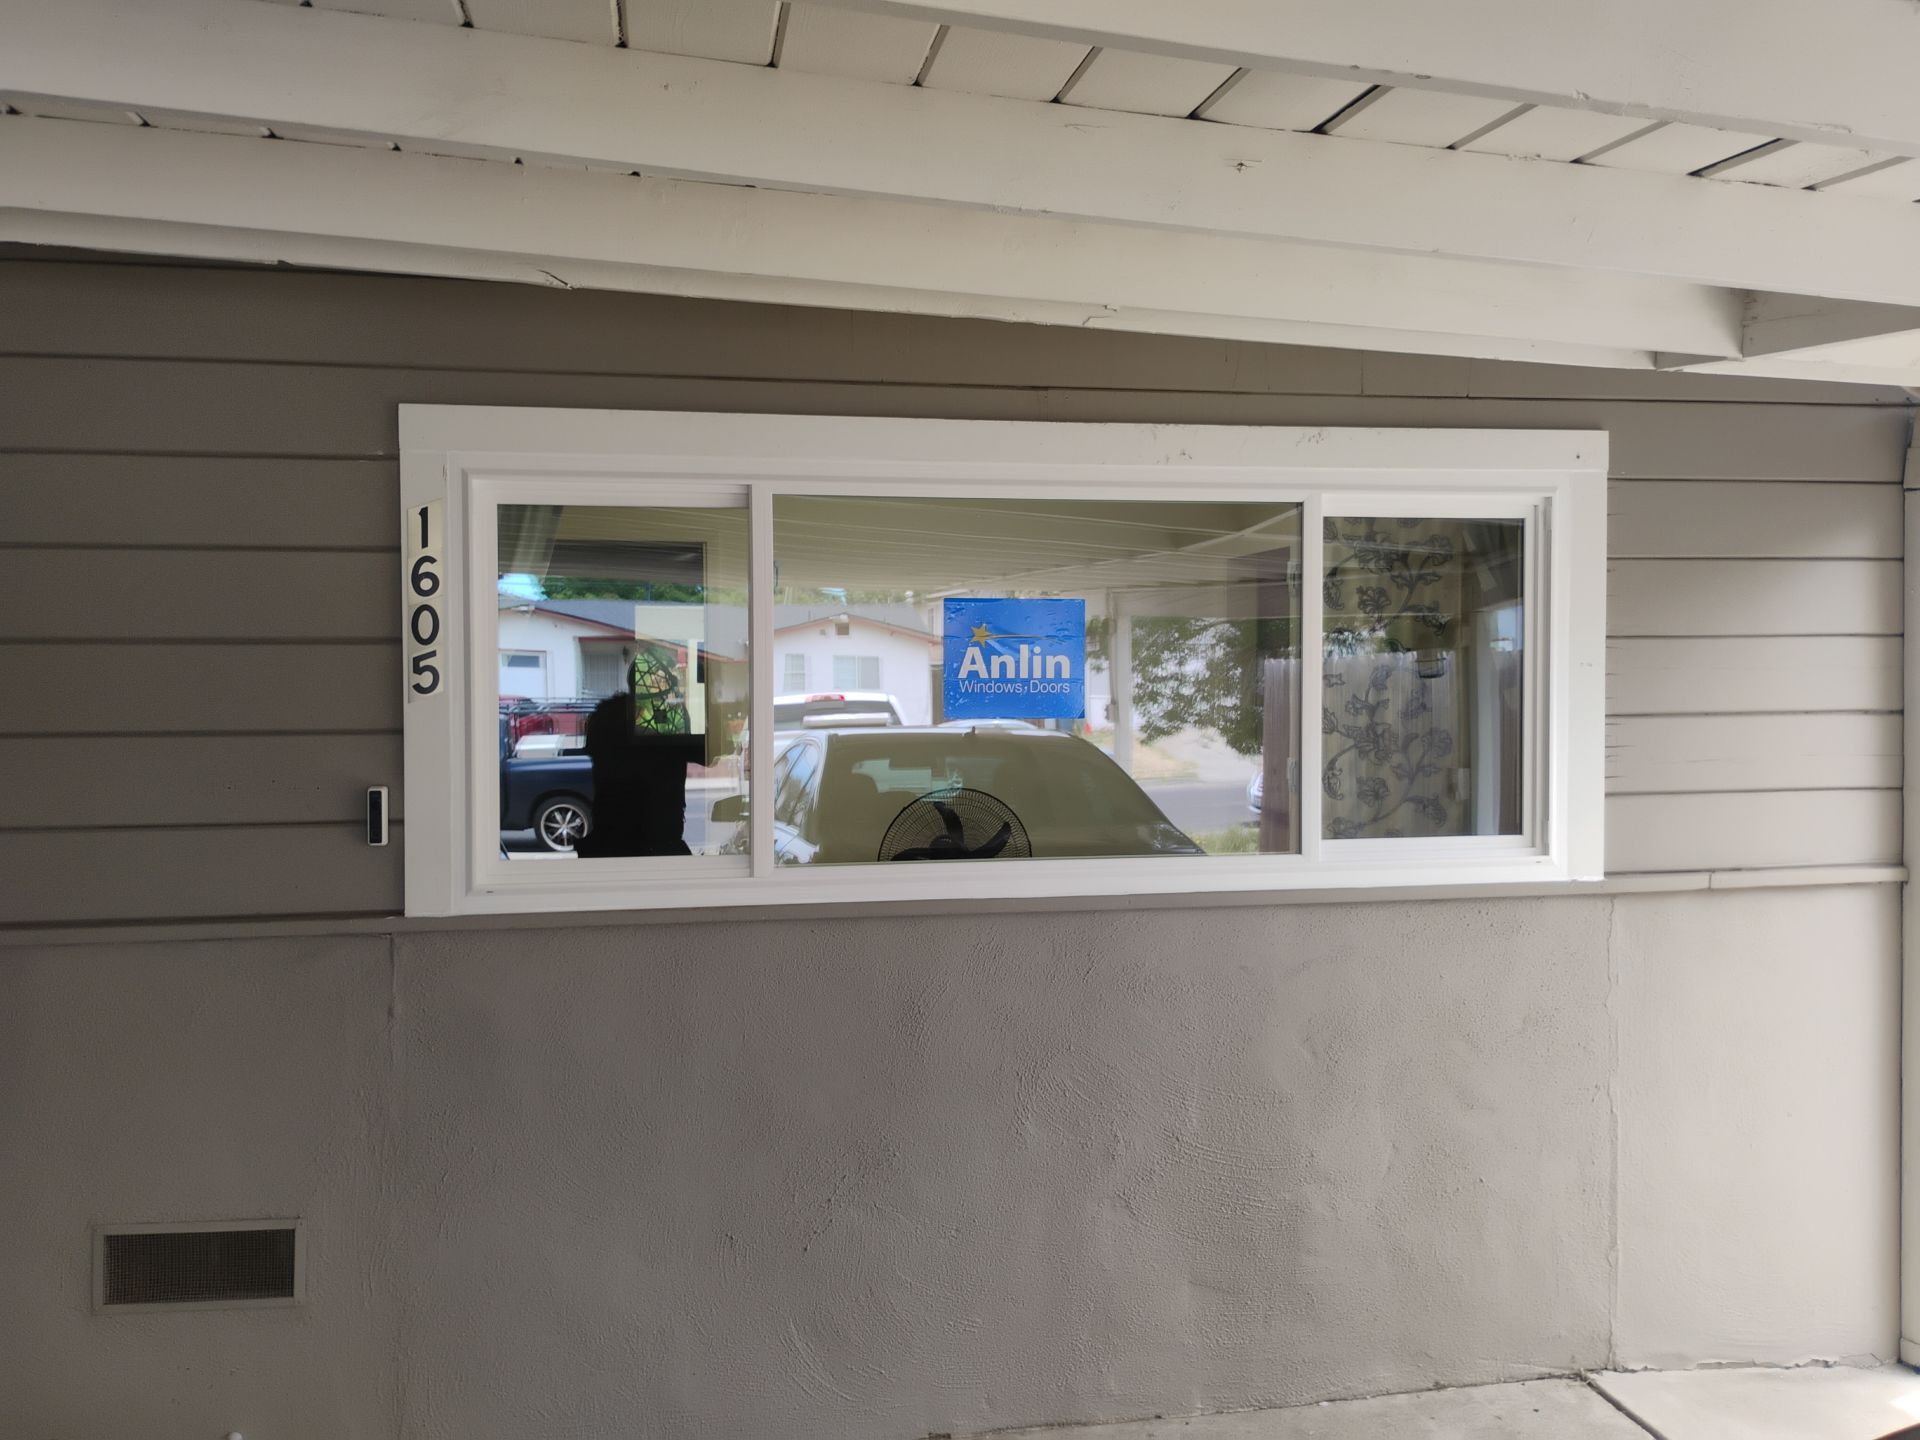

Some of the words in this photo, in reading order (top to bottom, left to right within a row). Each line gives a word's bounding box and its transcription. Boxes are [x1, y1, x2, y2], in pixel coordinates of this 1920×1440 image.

[411, 506, 440, 695] 1605
[958, 644, 1071, 679] Anlin
[1030, 680, 1070, 693] Doors
